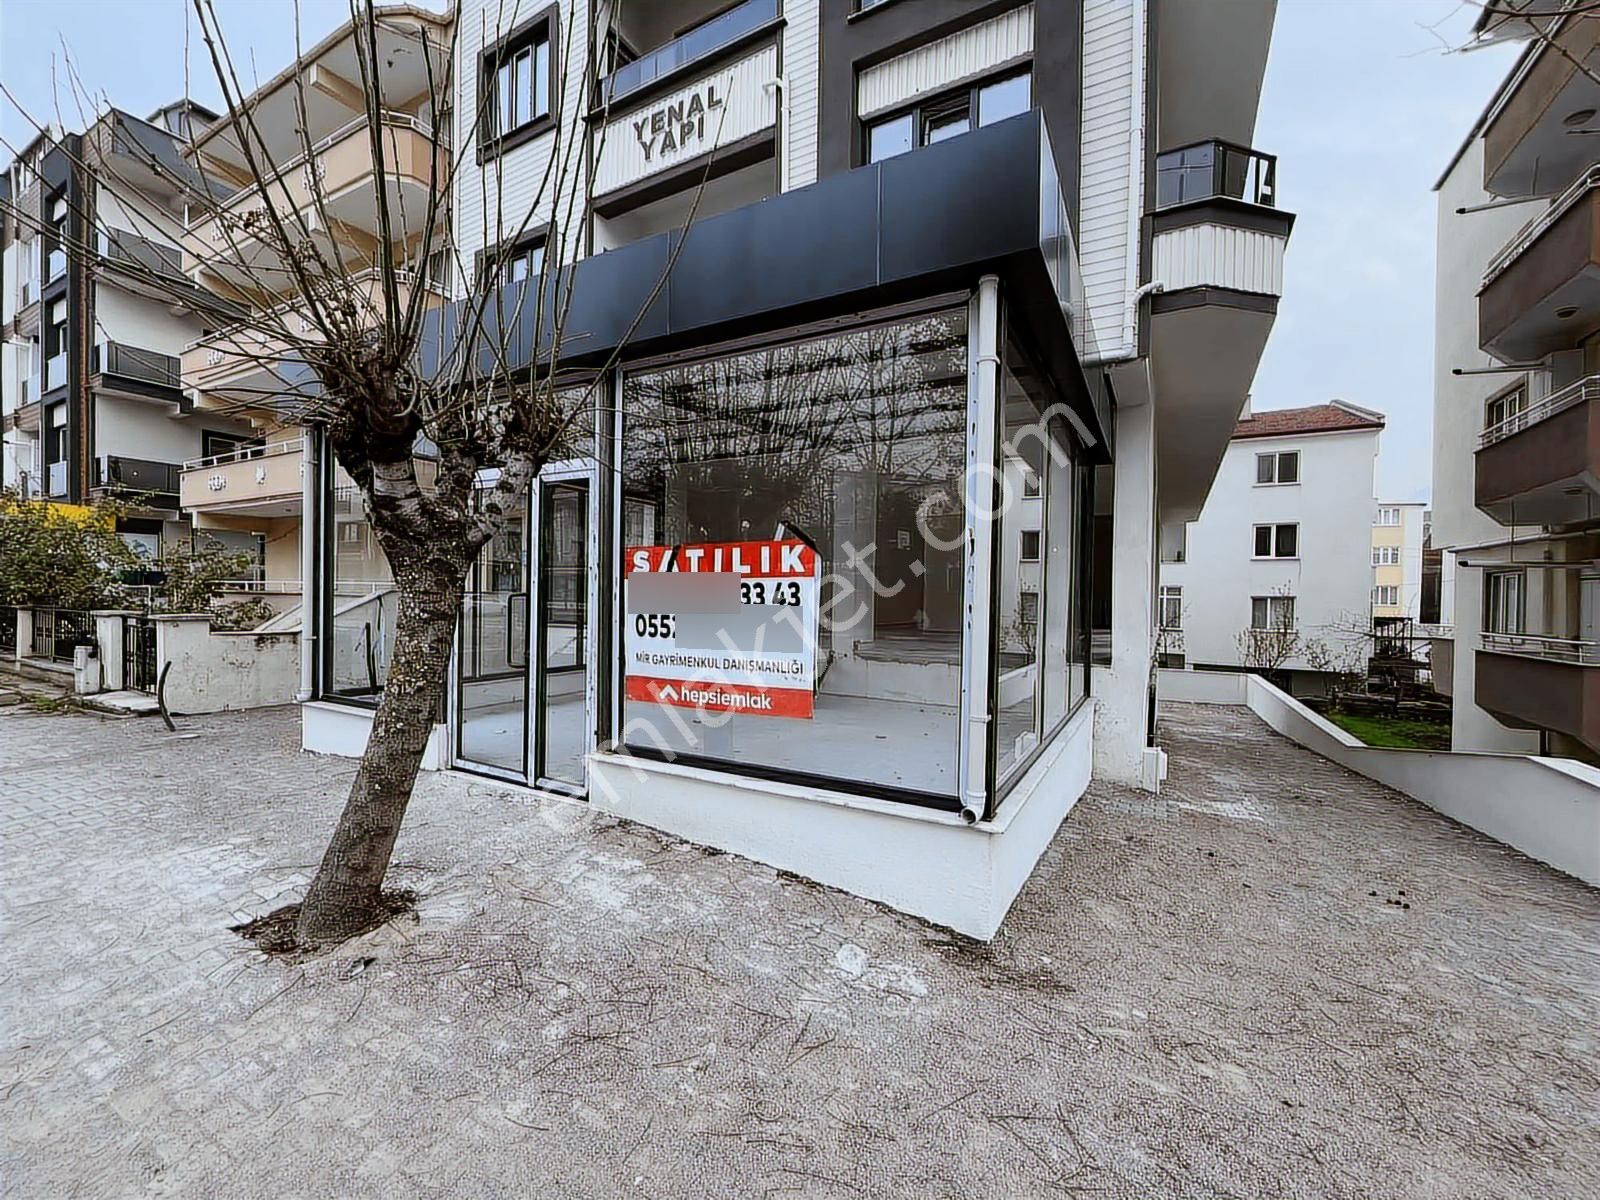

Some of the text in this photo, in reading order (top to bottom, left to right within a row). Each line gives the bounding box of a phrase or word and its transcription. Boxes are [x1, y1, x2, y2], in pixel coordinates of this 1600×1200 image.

[633, 86, 723, 141] YENAL
[640, 114, 705, 162] YAPI
[633, 544, 805, 573] SATILIK
[772, 581, 800, 606] 43
[635, 614, 676, 639] 055
[651, 652, 720, 669] GAYRİMENKUL
[722, 658, 804, 675] DANIŞMANLIĞI
[681, 686, 773, 710] hepsiemlak
